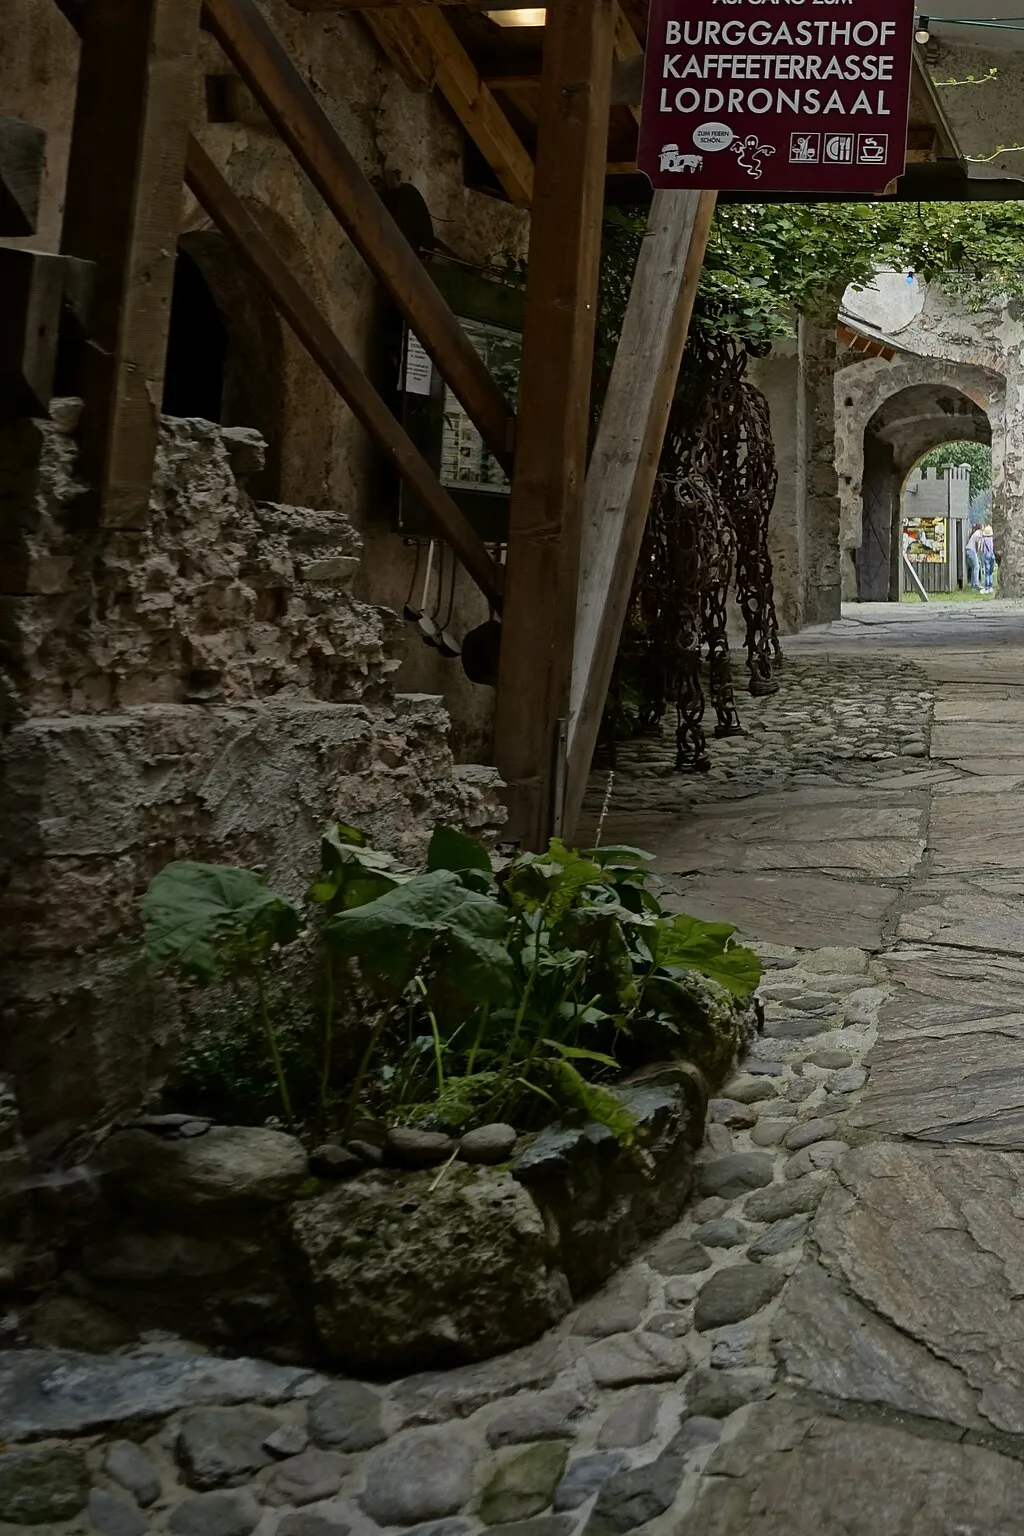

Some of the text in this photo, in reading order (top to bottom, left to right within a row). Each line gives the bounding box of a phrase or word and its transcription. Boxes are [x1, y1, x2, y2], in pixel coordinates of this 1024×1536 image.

[665, 20, 896, 46] BURGGASTHOF
[662, 54, 894, 80] KAFFEETERRASSE
[659, 87, 891, 115] LODRONSAAL
